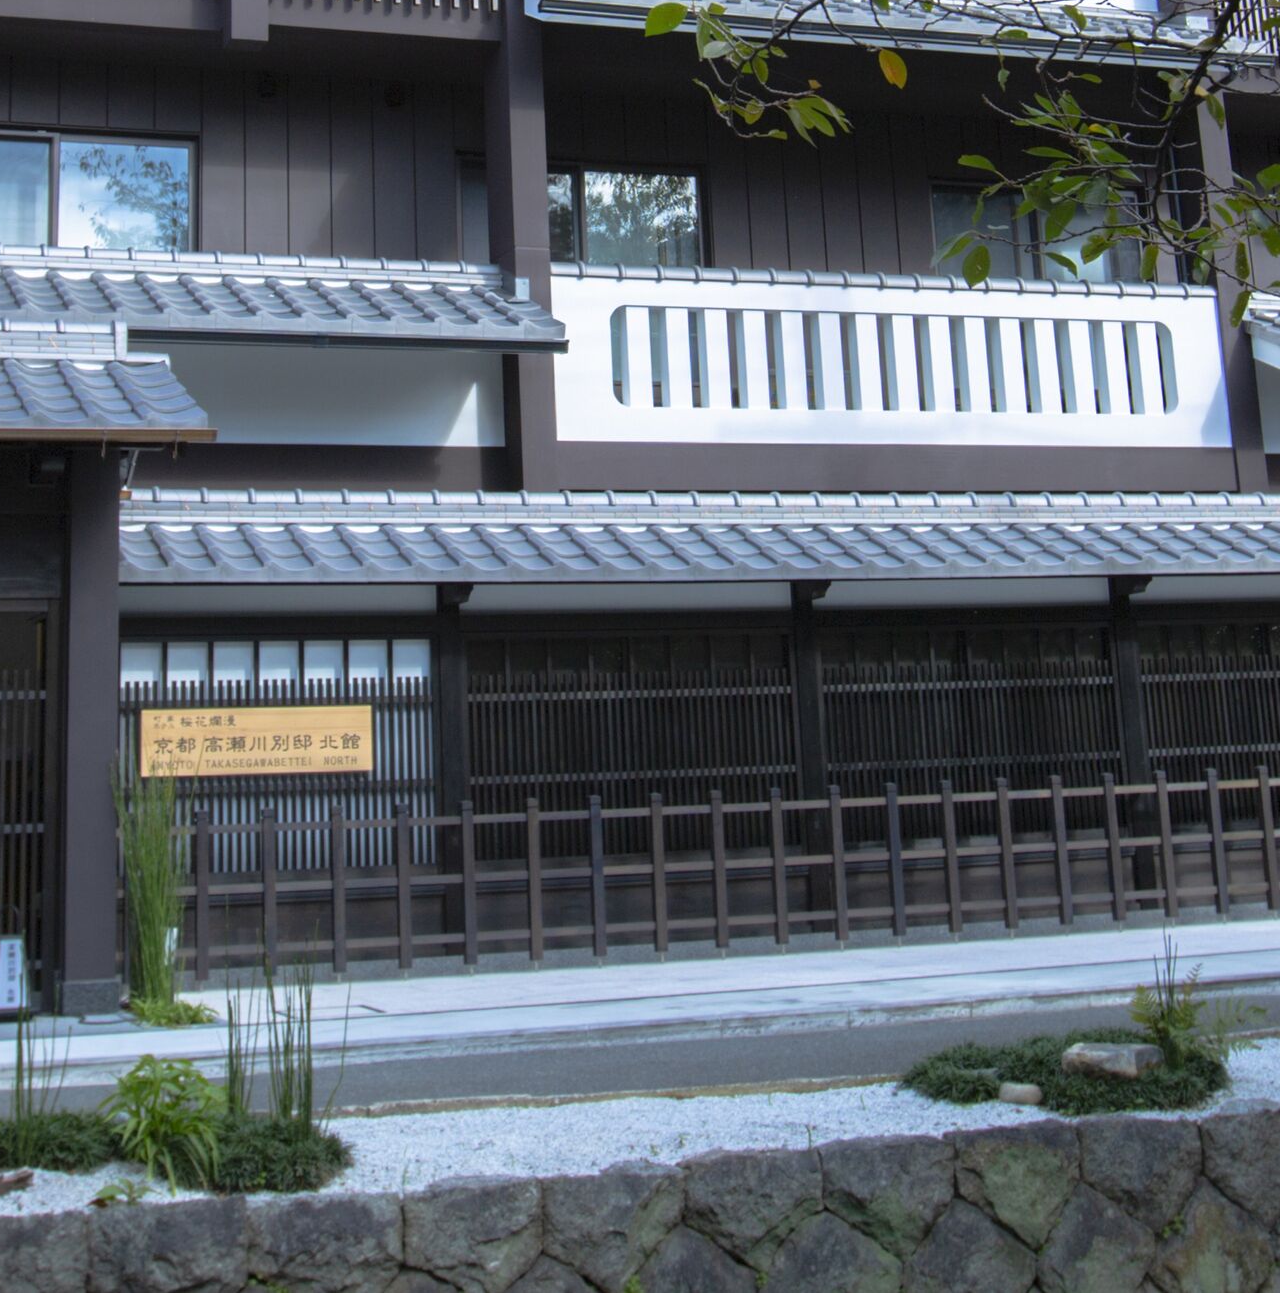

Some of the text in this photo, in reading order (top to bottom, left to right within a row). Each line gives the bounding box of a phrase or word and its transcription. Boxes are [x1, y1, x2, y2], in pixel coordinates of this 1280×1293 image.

[154, 733, 361, 754] 京都 高瀬川別邸 北館
[323, 755, 358, 766] NORTH
